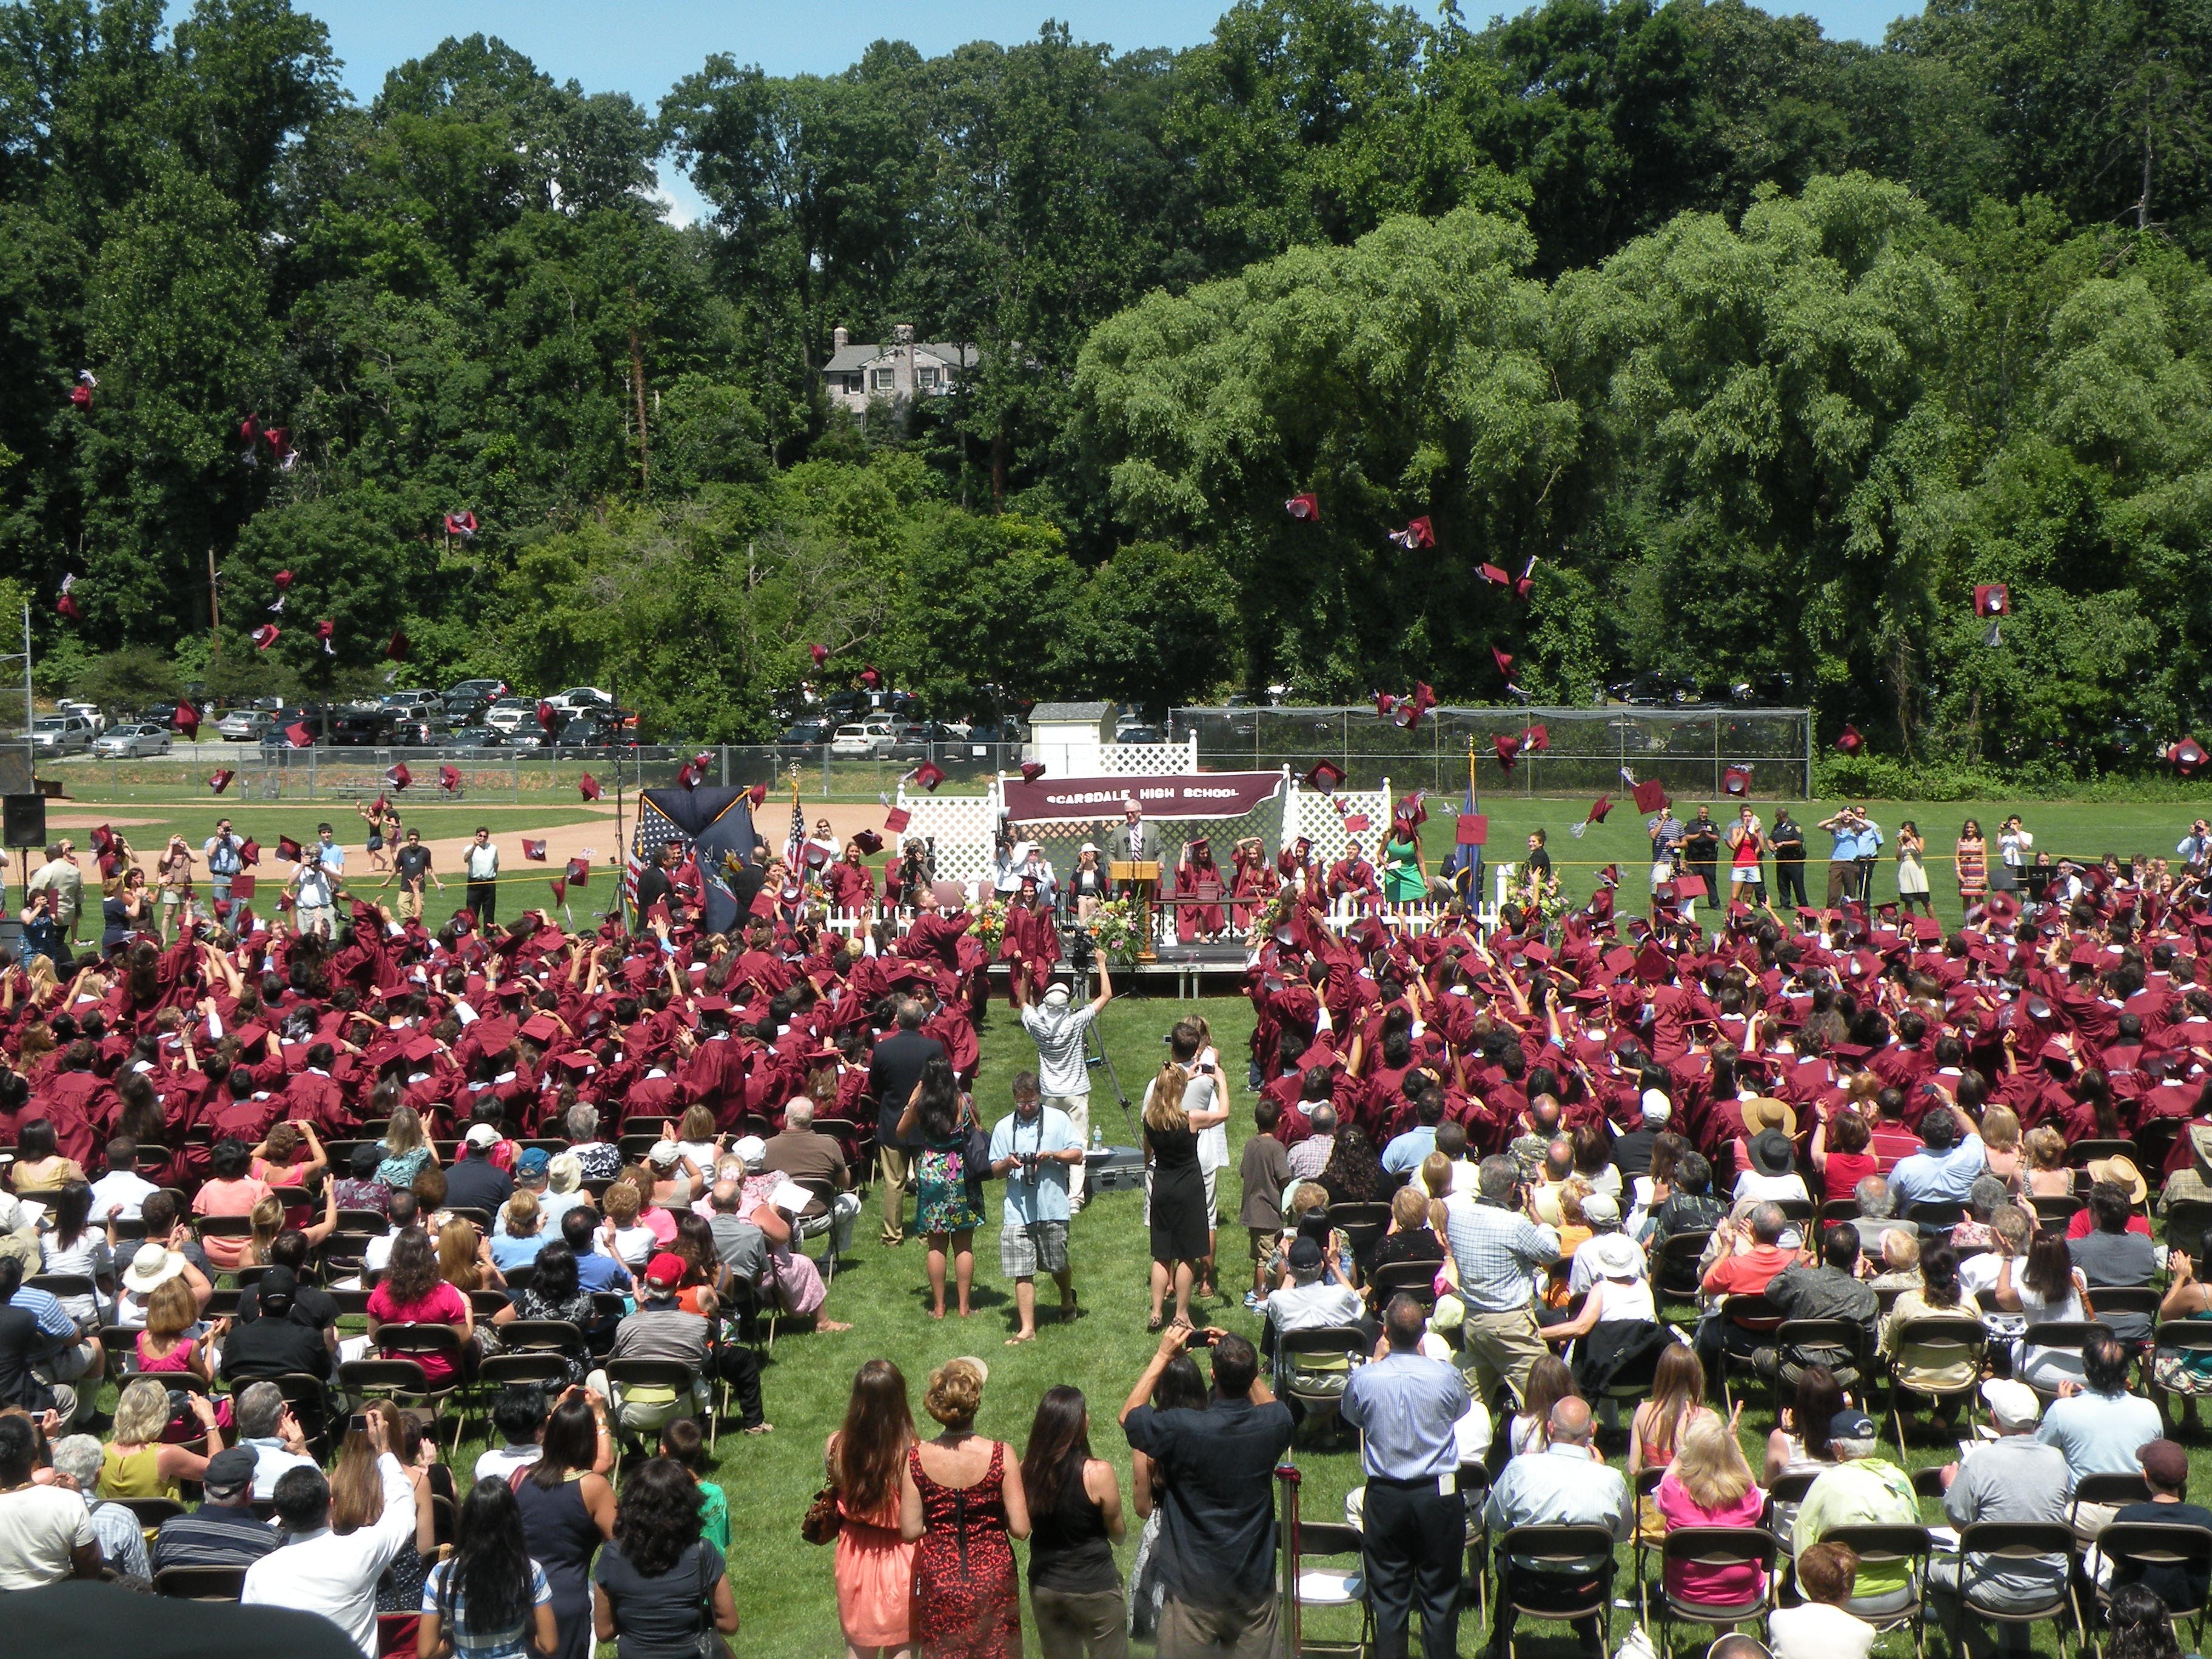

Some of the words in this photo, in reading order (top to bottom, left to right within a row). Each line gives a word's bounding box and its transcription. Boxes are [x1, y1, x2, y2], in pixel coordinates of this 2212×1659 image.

[1046, 789, 1131, 805] SCARSDALE
[1139, 788, 1175, 800] HIGH
[1183, 788, 1239, 799] SCHOOL
